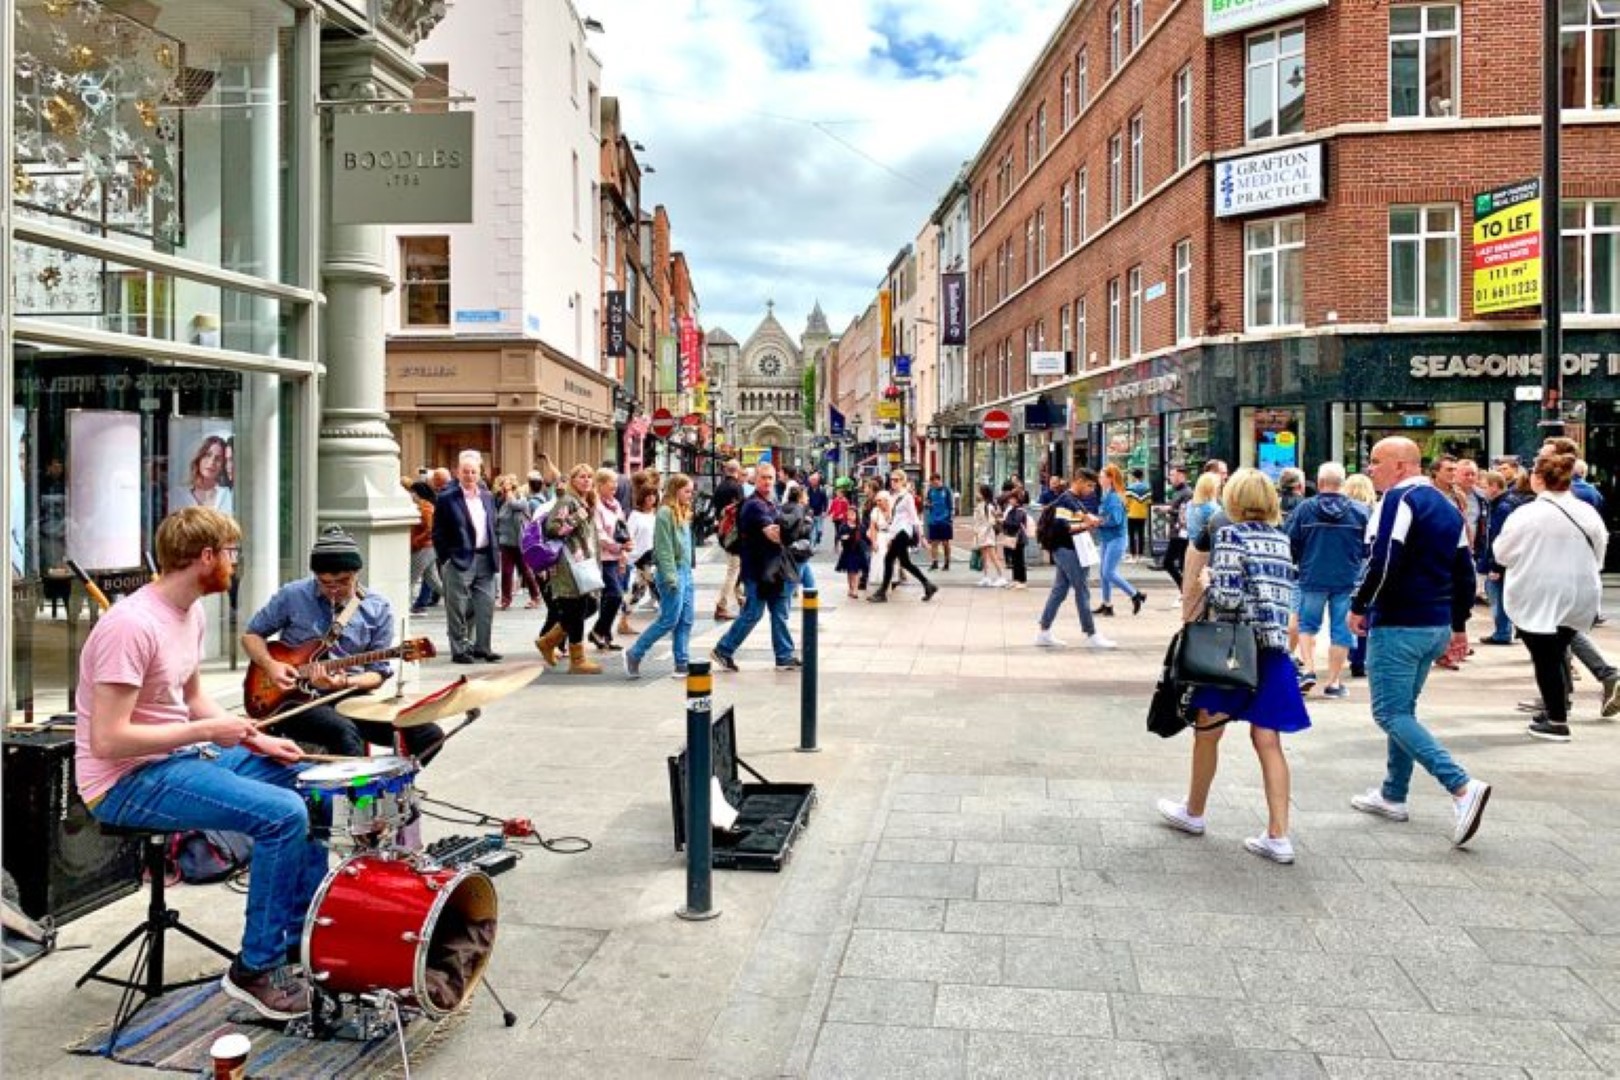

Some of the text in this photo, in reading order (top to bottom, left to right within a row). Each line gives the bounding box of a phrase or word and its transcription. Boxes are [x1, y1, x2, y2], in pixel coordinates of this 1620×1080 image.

[344, 150, 461, 171] BOODLES
[1237, 151, 1308, 175] GRAFTON
[1237, 166, 1311, 188] MEDICAL
[1237, 182, 1312, 204] PRACTICE
[1481, 212, 1532, 238] TO LET
[1476, 288, 1487, 301] 01
[611, 293, 623, 353] INGLOT
[1410, 353, 1544, 377] SEASONS
[1559, 352, 1601, 375] OF
